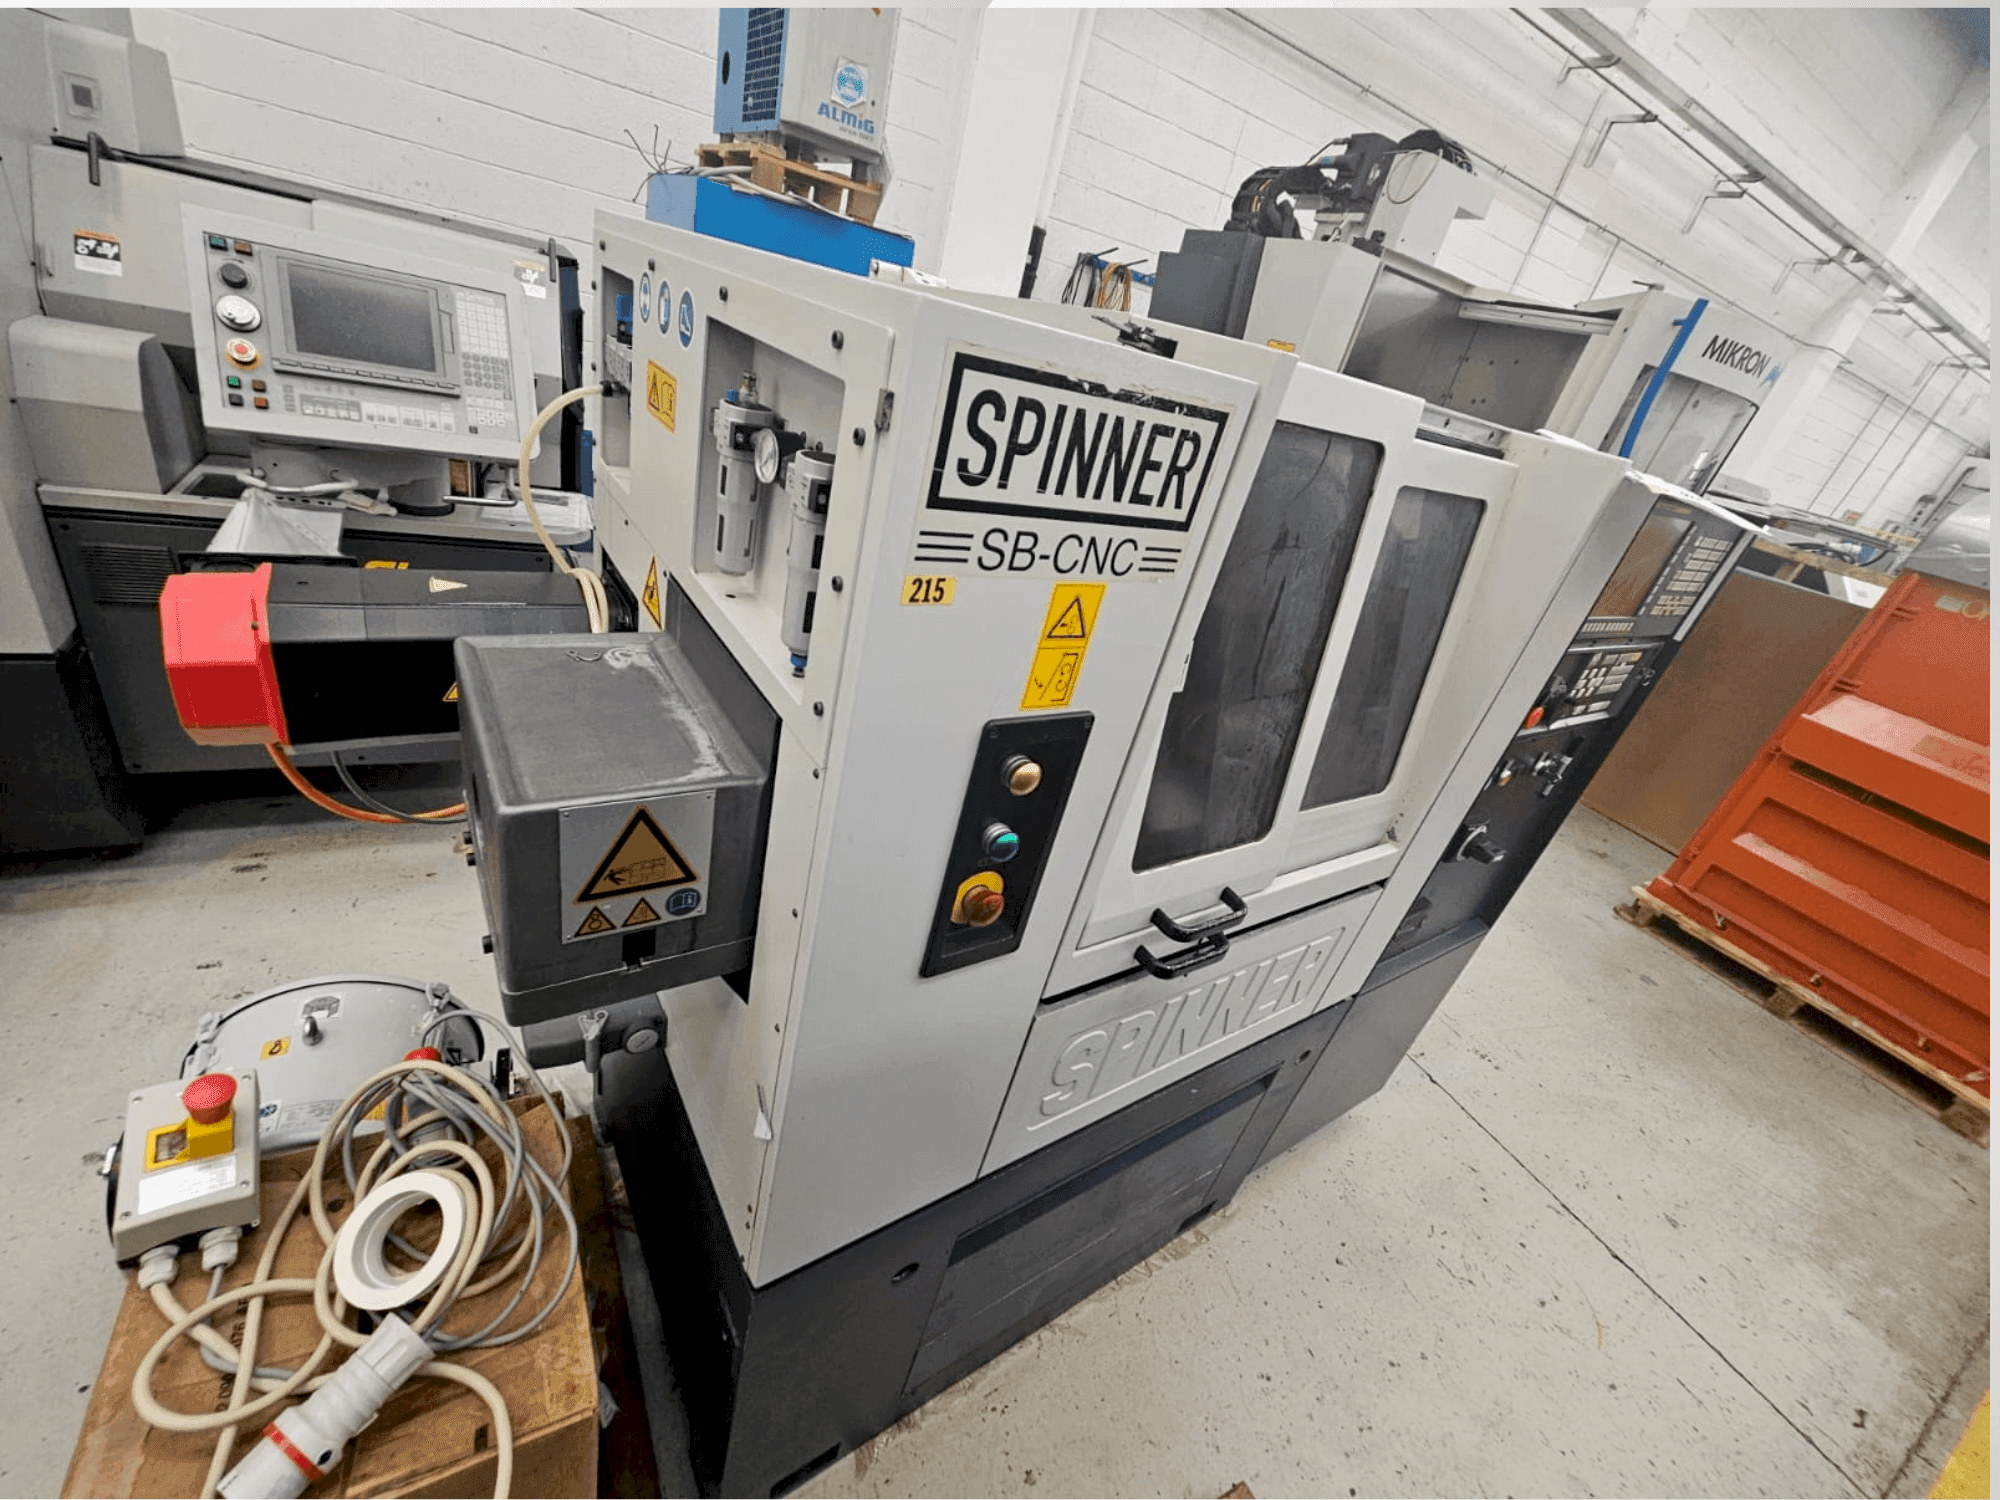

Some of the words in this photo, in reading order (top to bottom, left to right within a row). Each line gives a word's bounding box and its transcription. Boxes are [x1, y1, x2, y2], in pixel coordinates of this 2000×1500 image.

[1701, 334, 1772, 379] MIKRON
[956, 389, 1202, 510] SPINNER
[977, 527, 1139, 577] SB-CNC
[908, 577, 947, 603] 215
[1040, 934, 1336, 1118] SPINNER
